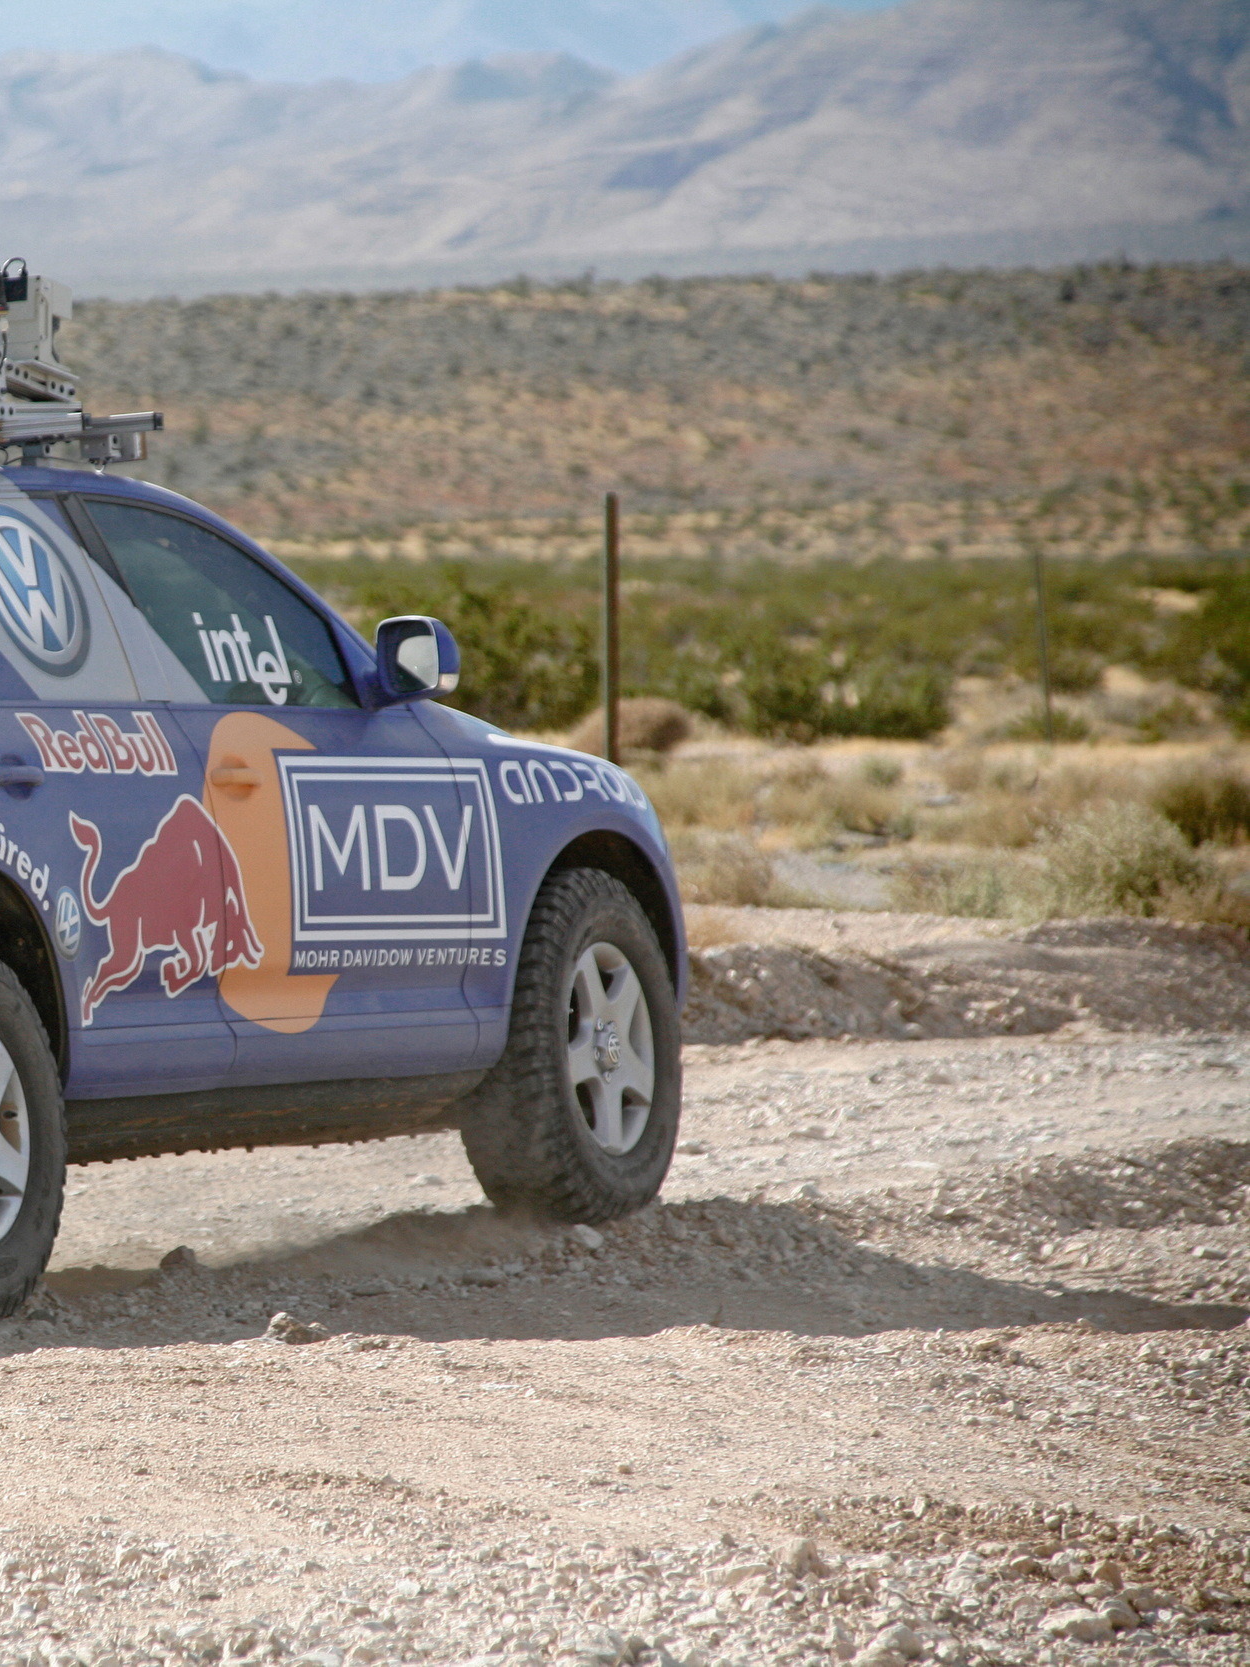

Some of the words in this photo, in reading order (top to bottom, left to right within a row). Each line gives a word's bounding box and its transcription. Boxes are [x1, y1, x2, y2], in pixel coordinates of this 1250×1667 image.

[192, 611, 293, 707] intel
[307, 804, 474, 892] MDV
[293, 949, 340, 969] MOHR
[342, 948, 414, 968] DAVIDOW
[416, 947, 508, 967] VENTURES
